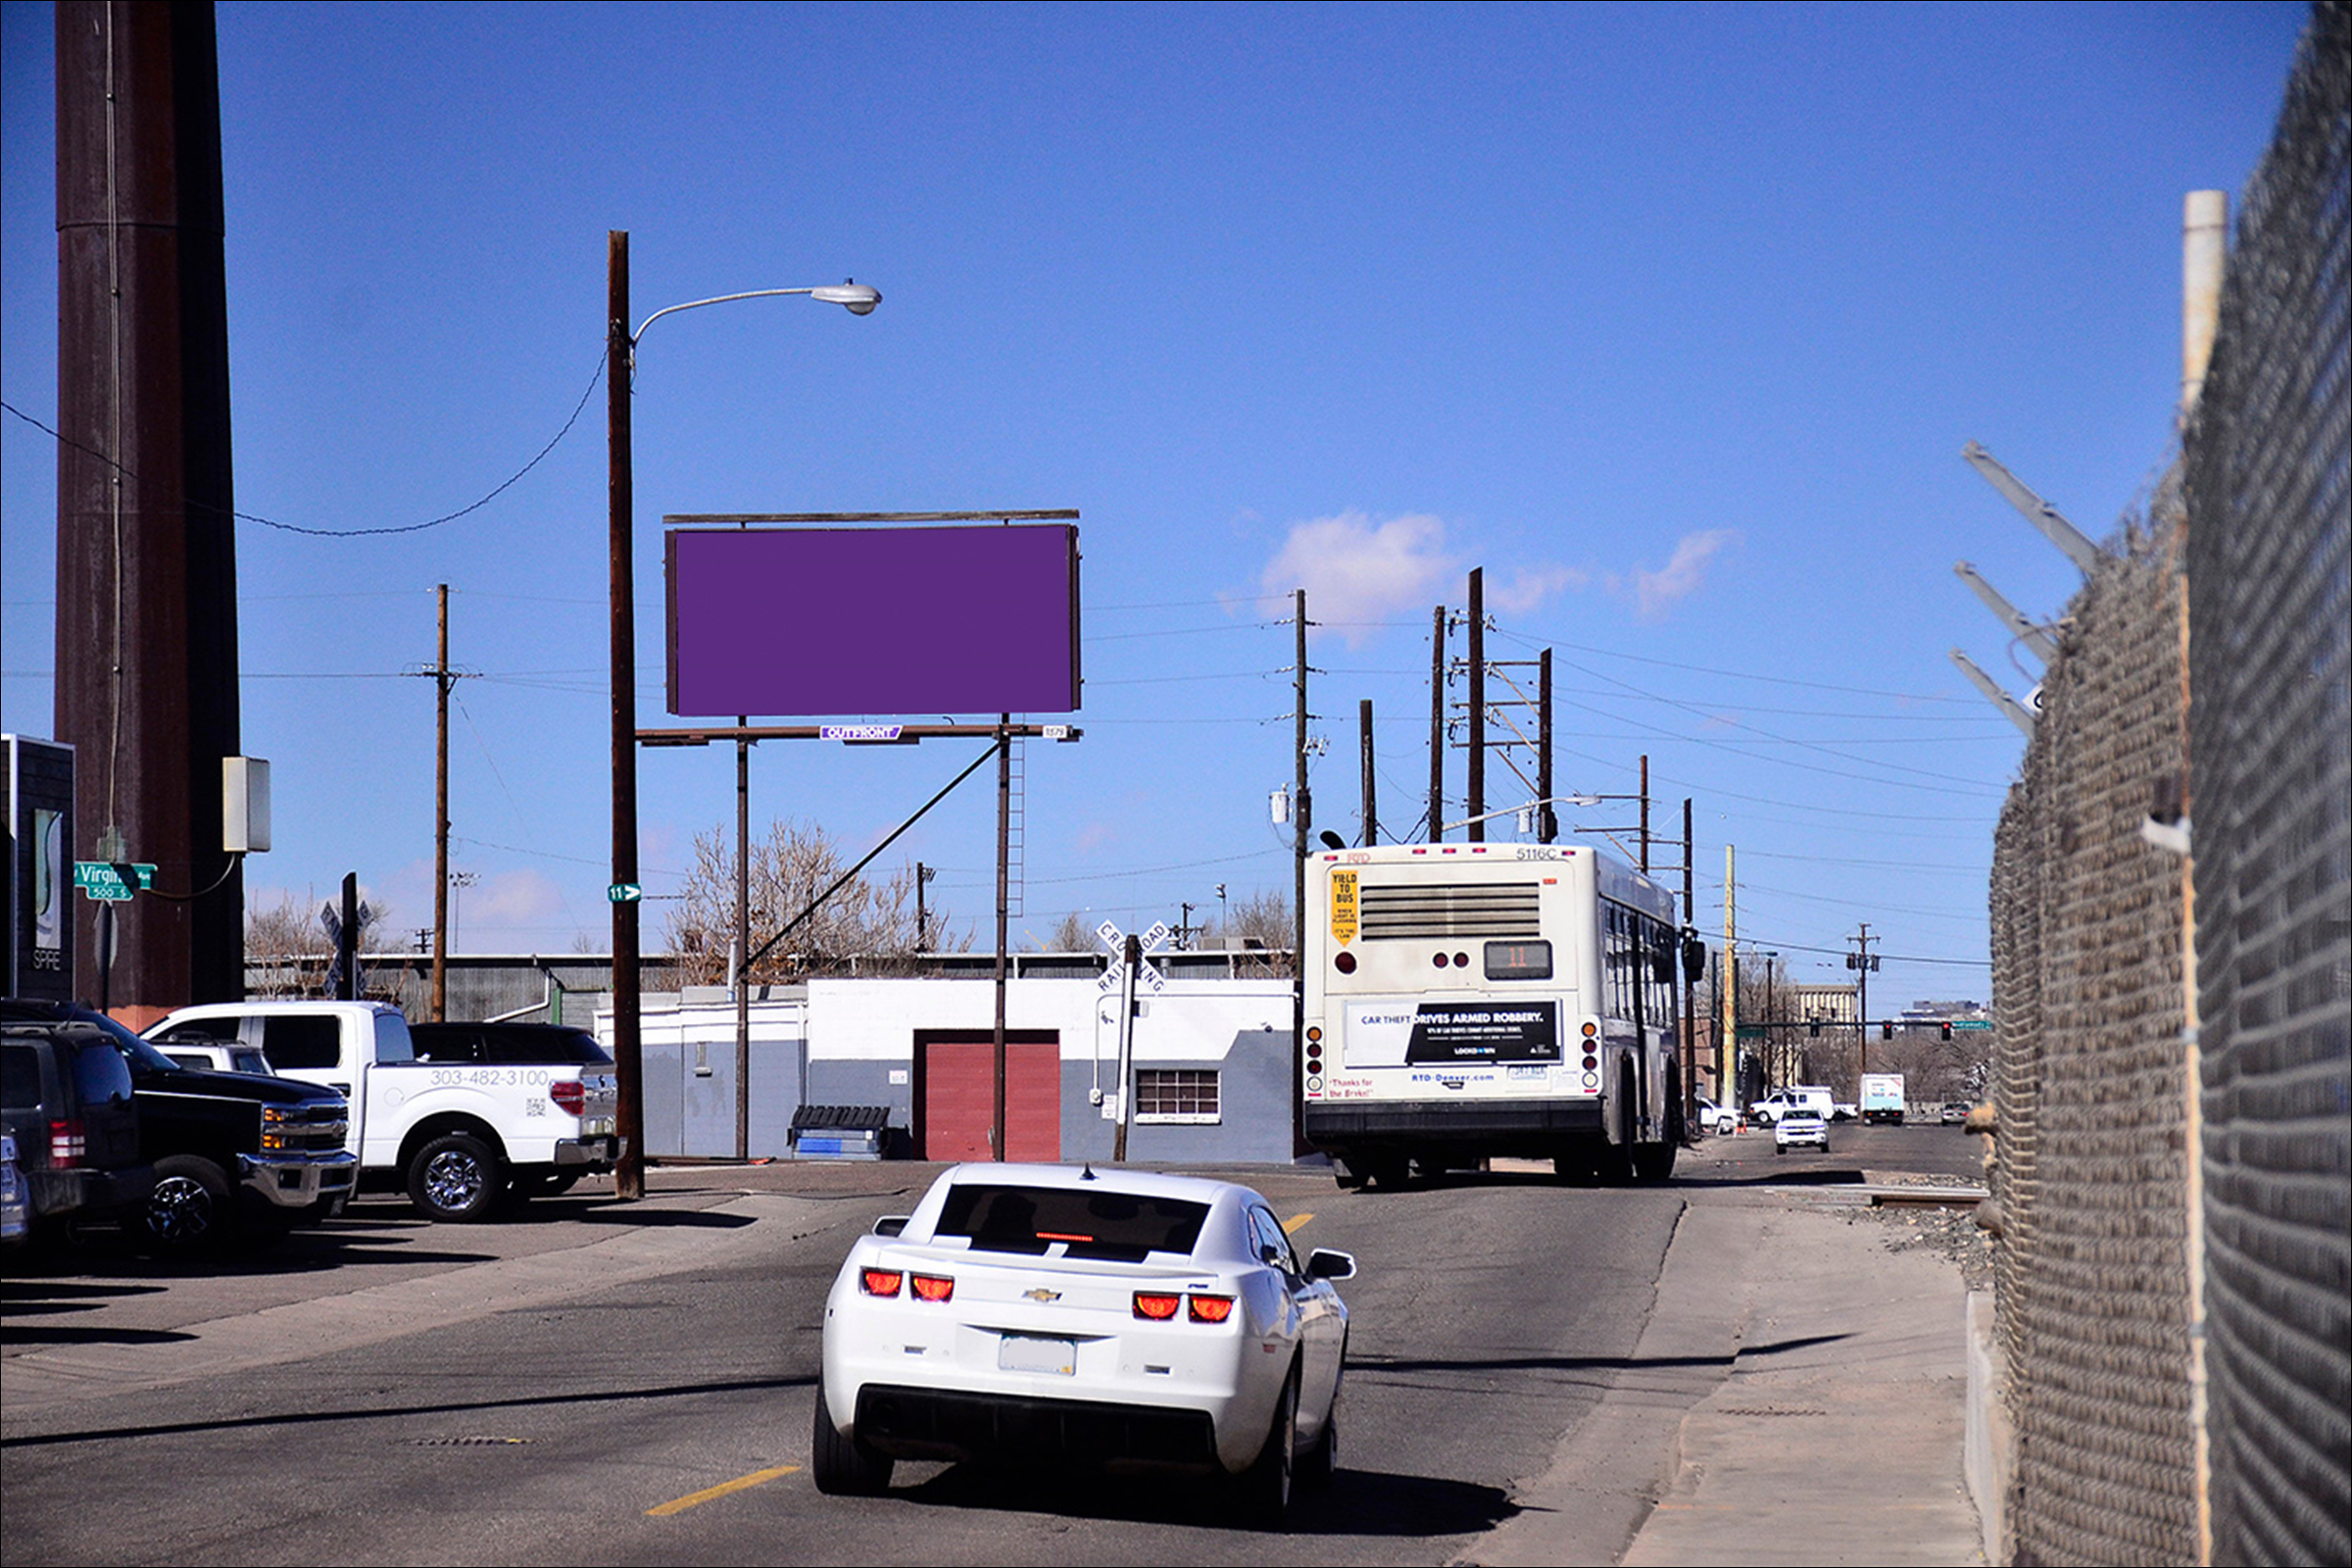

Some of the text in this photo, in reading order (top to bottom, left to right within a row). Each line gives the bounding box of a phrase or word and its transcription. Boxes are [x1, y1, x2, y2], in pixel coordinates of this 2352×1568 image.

[827, 727, 894, 738] OUTFRONT
[1516, 848, 1557, 861] 5116C
[80, 865, 133, 886] Virgina
[1333, 874, 1357, 884] YIELD
[610, 886, 623, 901] 11
[1340, 884, 1350, 893] TO
[1337, 894, 1353, 903] BUS
[1097, 924, 1166, 993] RAILOAD
[1101, 923, 1165, 993] CROING
[1508, 947, 1527, 967] 11
[1361, 1015, 1382, 1025] CAR
[1413, 1013, 1449, 1024] DRIVES
[1452, 1012, 1491, 1023] ARMED
[1493, 1011, 1544, 1022] ROBBERY.
[430, 1069, 549, 1085] 303-482-3100
